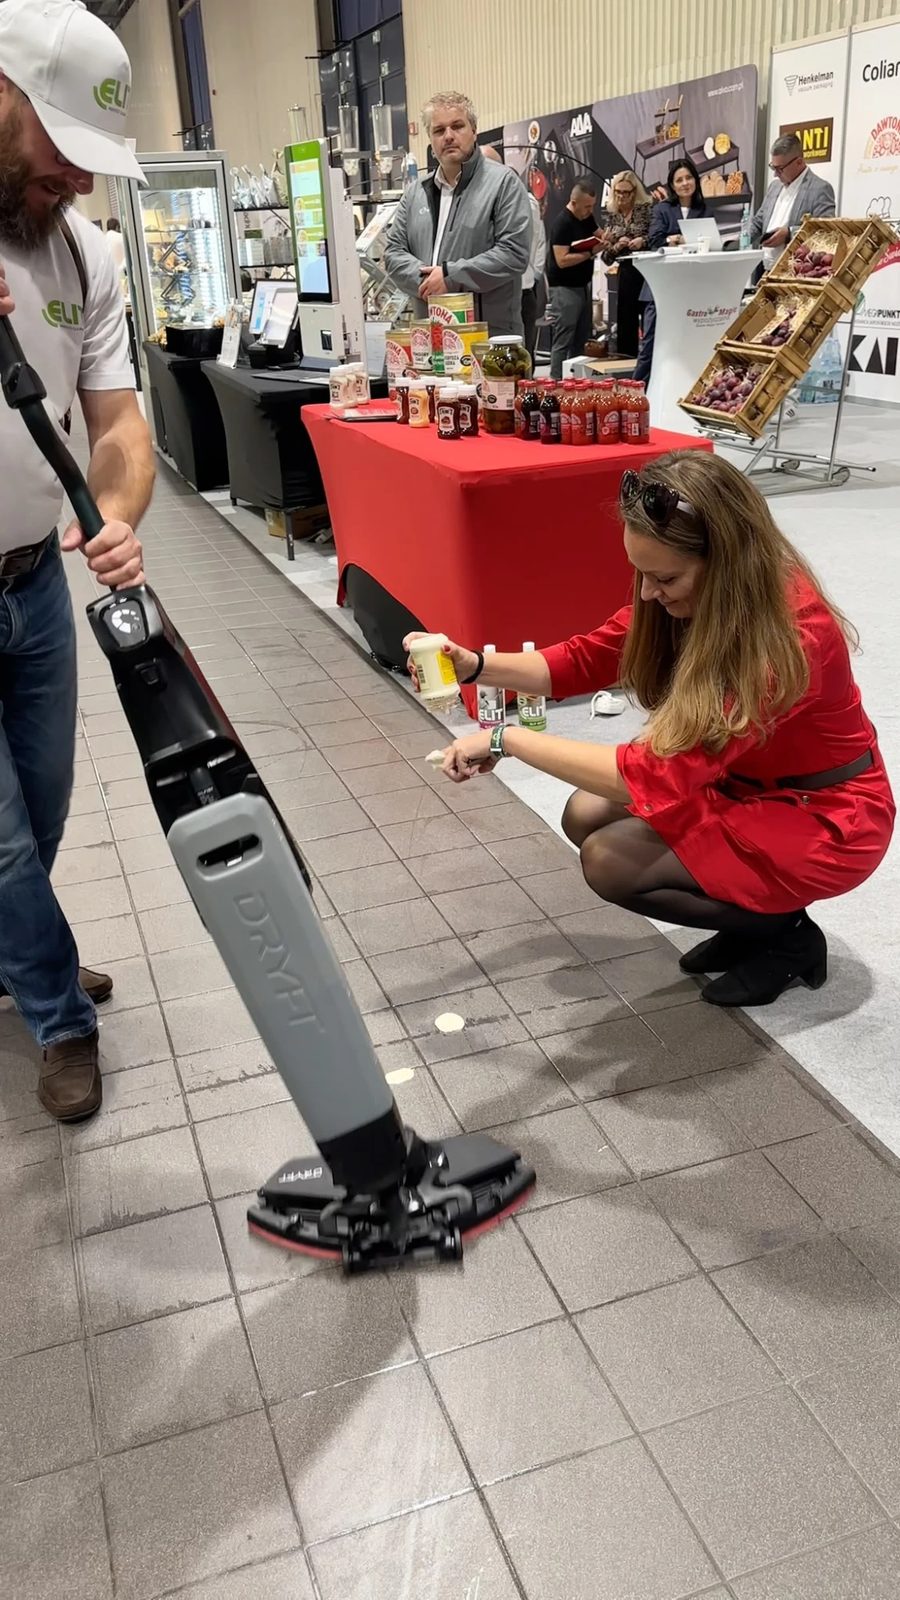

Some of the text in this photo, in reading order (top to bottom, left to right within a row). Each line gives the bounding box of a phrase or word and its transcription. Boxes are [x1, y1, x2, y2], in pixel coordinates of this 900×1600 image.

[798, 71, 834, 85] Henkelman
[99, 78, 130, 109] ELI
[47, 299, 82, 325] ELI
[686, 309, 708, 317] Gastro
[847, 334, 899, 376] KAI
[479, 708, 503, 721] ELIT
[520, 705, 545, 718] ELIT
